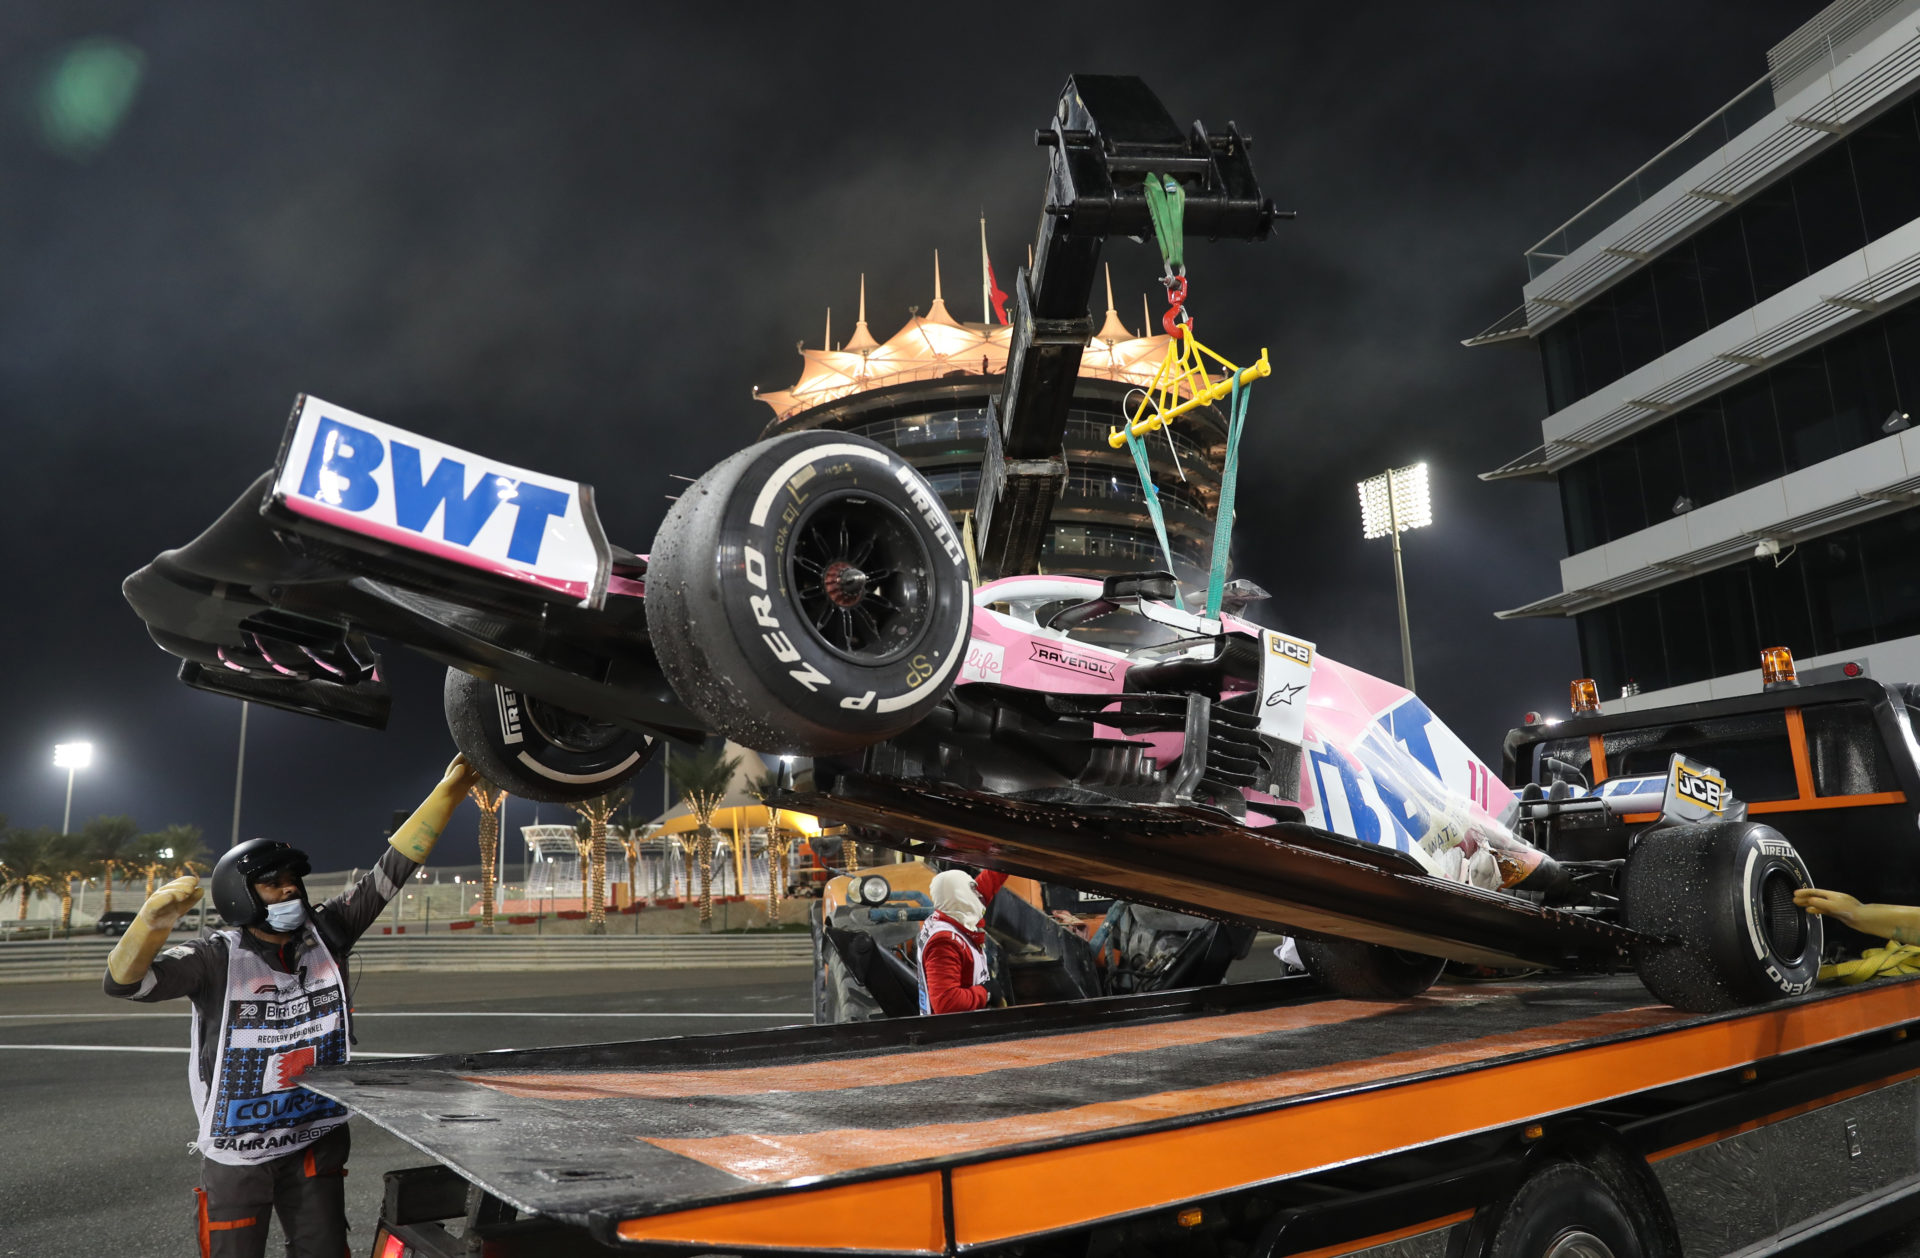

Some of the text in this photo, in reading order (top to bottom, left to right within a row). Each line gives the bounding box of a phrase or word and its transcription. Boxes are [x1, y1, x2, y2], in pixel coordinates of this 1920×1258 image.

[298, 414, 571, 566] BWT
[895, 465, 966, 566] PIRELLI
[743, 545, 832, 693] ZERO
[1038, 649, 1108, 675] RAVENOL
[1272, 638, 1311, 665] JCB
[1467, 759, 1489, 812] 11
[1679, 772, 1721, 808] JCB
[1756, 839, 1796, 858] PIRELLI
[1766, 965, 1813, 996] ZERO
[289, 1023, 323, 1041] PERONNEL
[214, 1123, 341, 1151] BAHRAIN 202
